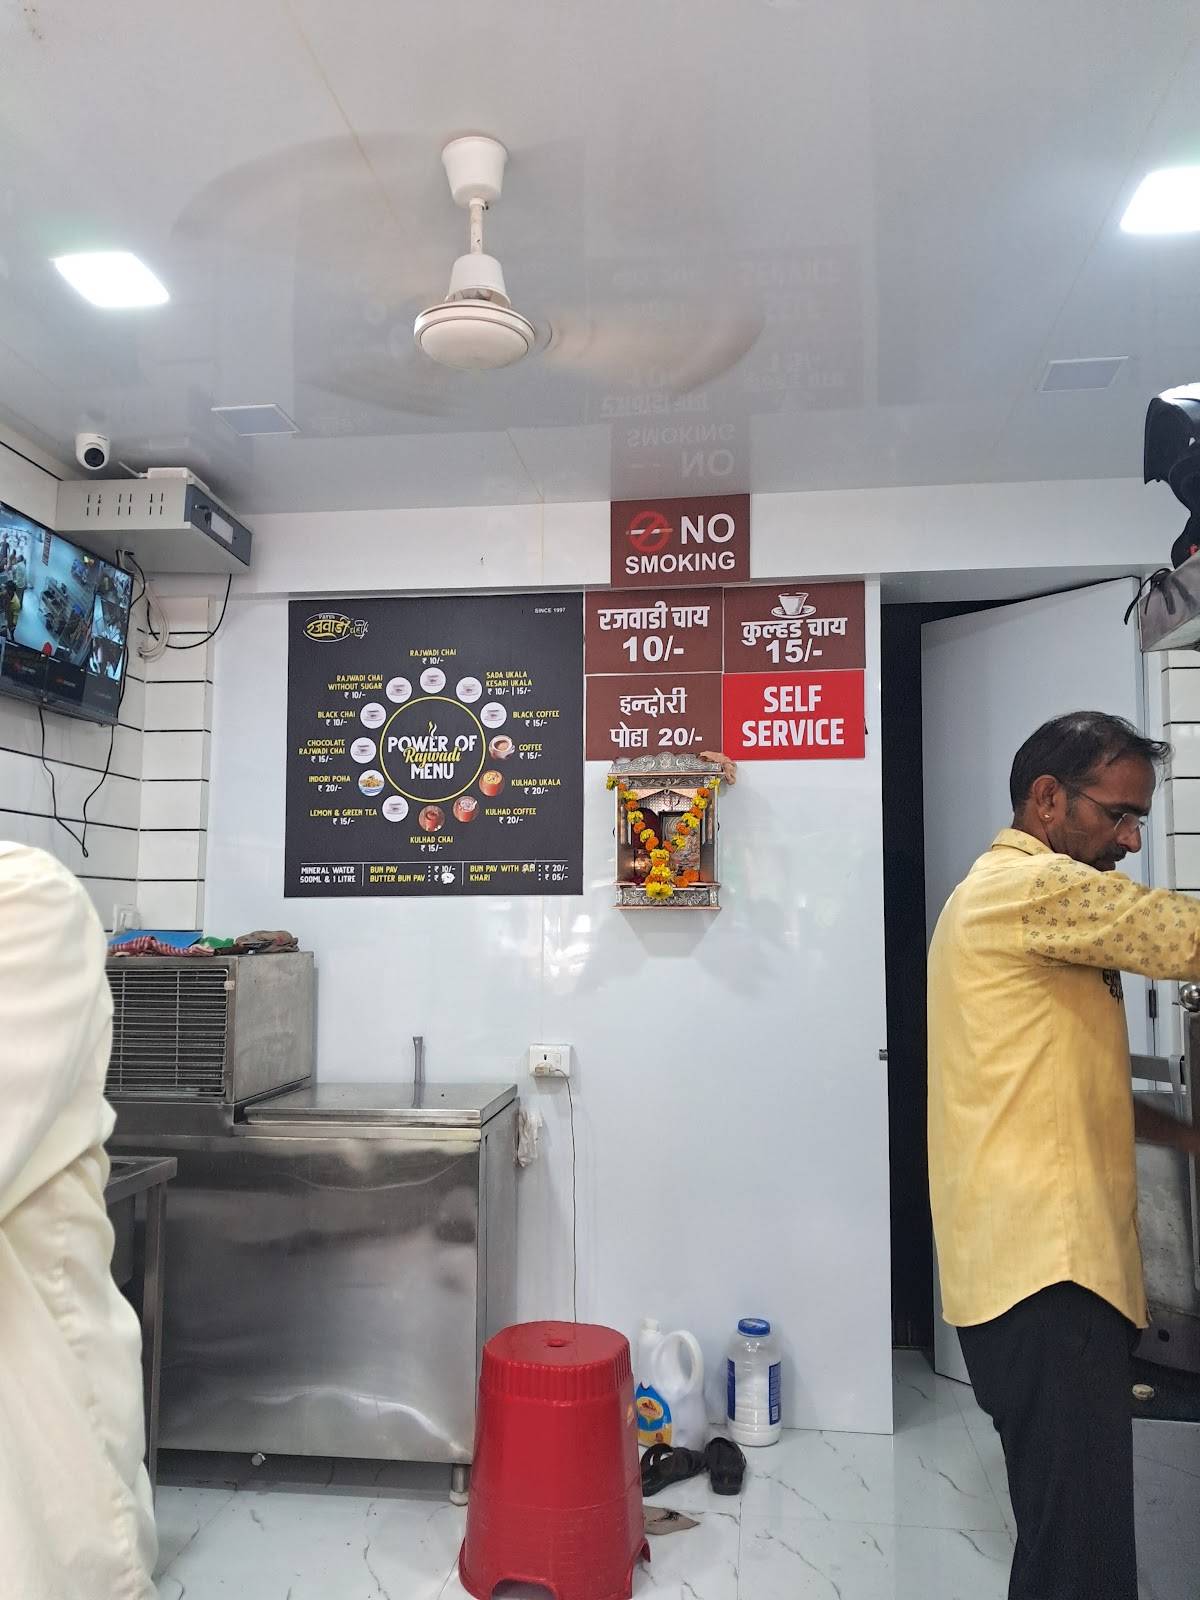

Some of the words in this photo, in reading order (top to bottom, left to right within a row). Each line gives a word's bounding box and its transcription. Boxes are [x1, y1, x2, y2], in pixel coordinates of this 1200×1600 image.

[680, 513, 736, 545] NO
[625, 551, 736, 575] SMOKING
[598, 600, 668, 631] रजवाडी
[671, 606, 710, 628] चाय
[806, 617, 848, 636] चाय
[622, 635, 684, 662] 10/-
[765, 638, 823, 663] 15/-
[351, 691, 366, 699] 10/-
[516, 687, 531, 695] 15/-
[764, 685, 822, 713] SELF
[619, 687, 687, 717] इन्दोरी
[533, 719, 548, 727] 15/-
[609, 721, 649, 748] पोहा
[658, 728, 703, 746] 20/-
[742, 719, 844, 747] SERVICE
[387, 735, 449, 753] POWER
[454, 734, 478, 752] OF
[318, 755, 333, 763] 15/-
[403, 745, 461, 769] Rajwadi
[410, 763, 454, 780] MENU
[325, 784, 342, 792] 20/-
[532, 786, 549, 794] 20/-
[539, 778, 561, 786] UKALA
[340, 817, 355, 825] 15/-
[506, 815, 523, 824] 20/-
[332, 866, 355, 874] WATER
[552, 864, 569, 872] 20/-
[552, 873, 569, 881] 05/-
